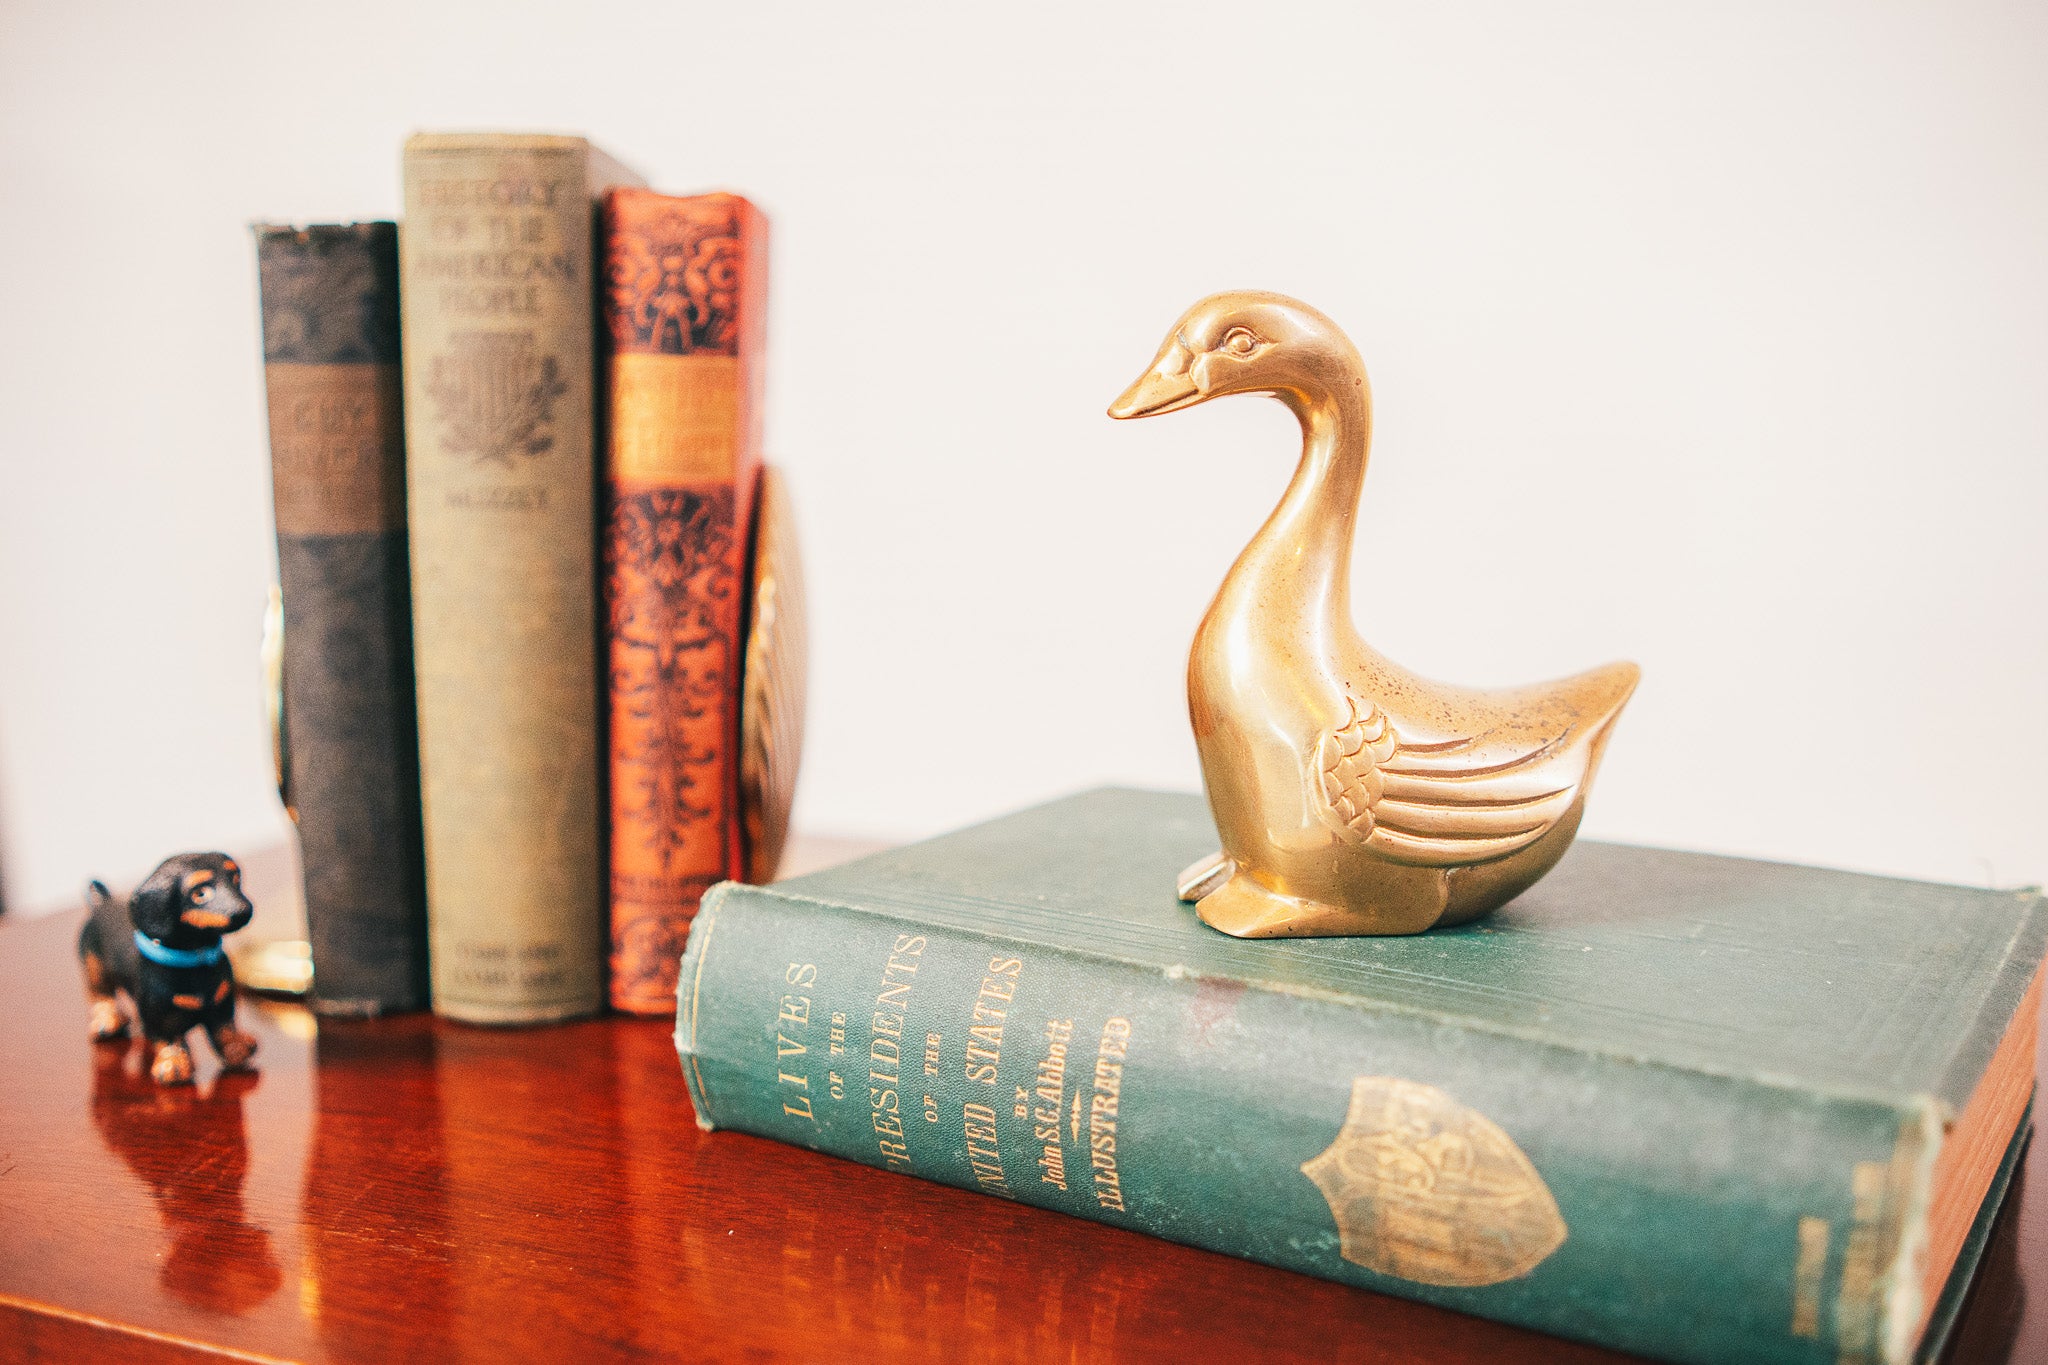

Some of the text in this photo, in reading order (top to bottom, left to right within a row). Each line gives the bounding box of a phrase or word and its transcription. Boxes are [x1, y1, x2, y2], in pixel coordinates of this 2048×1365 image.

[414, 250, 578, 283] AMERICAN
[439, 286, 543, 316] PEOPLE
[776, 963, 817, 1121] LIVES
[830, 1012, 847, 1100] OF THE
[966, 957, 1022, 1085] STATES
[924, 1033, 942, 1123] OF THE
[1014, 1086, 1039, 1119] BY
[1090, 1017, 1131, 1212] ILLUSTRATED
[1038, 1145, 1067, 1190] John
